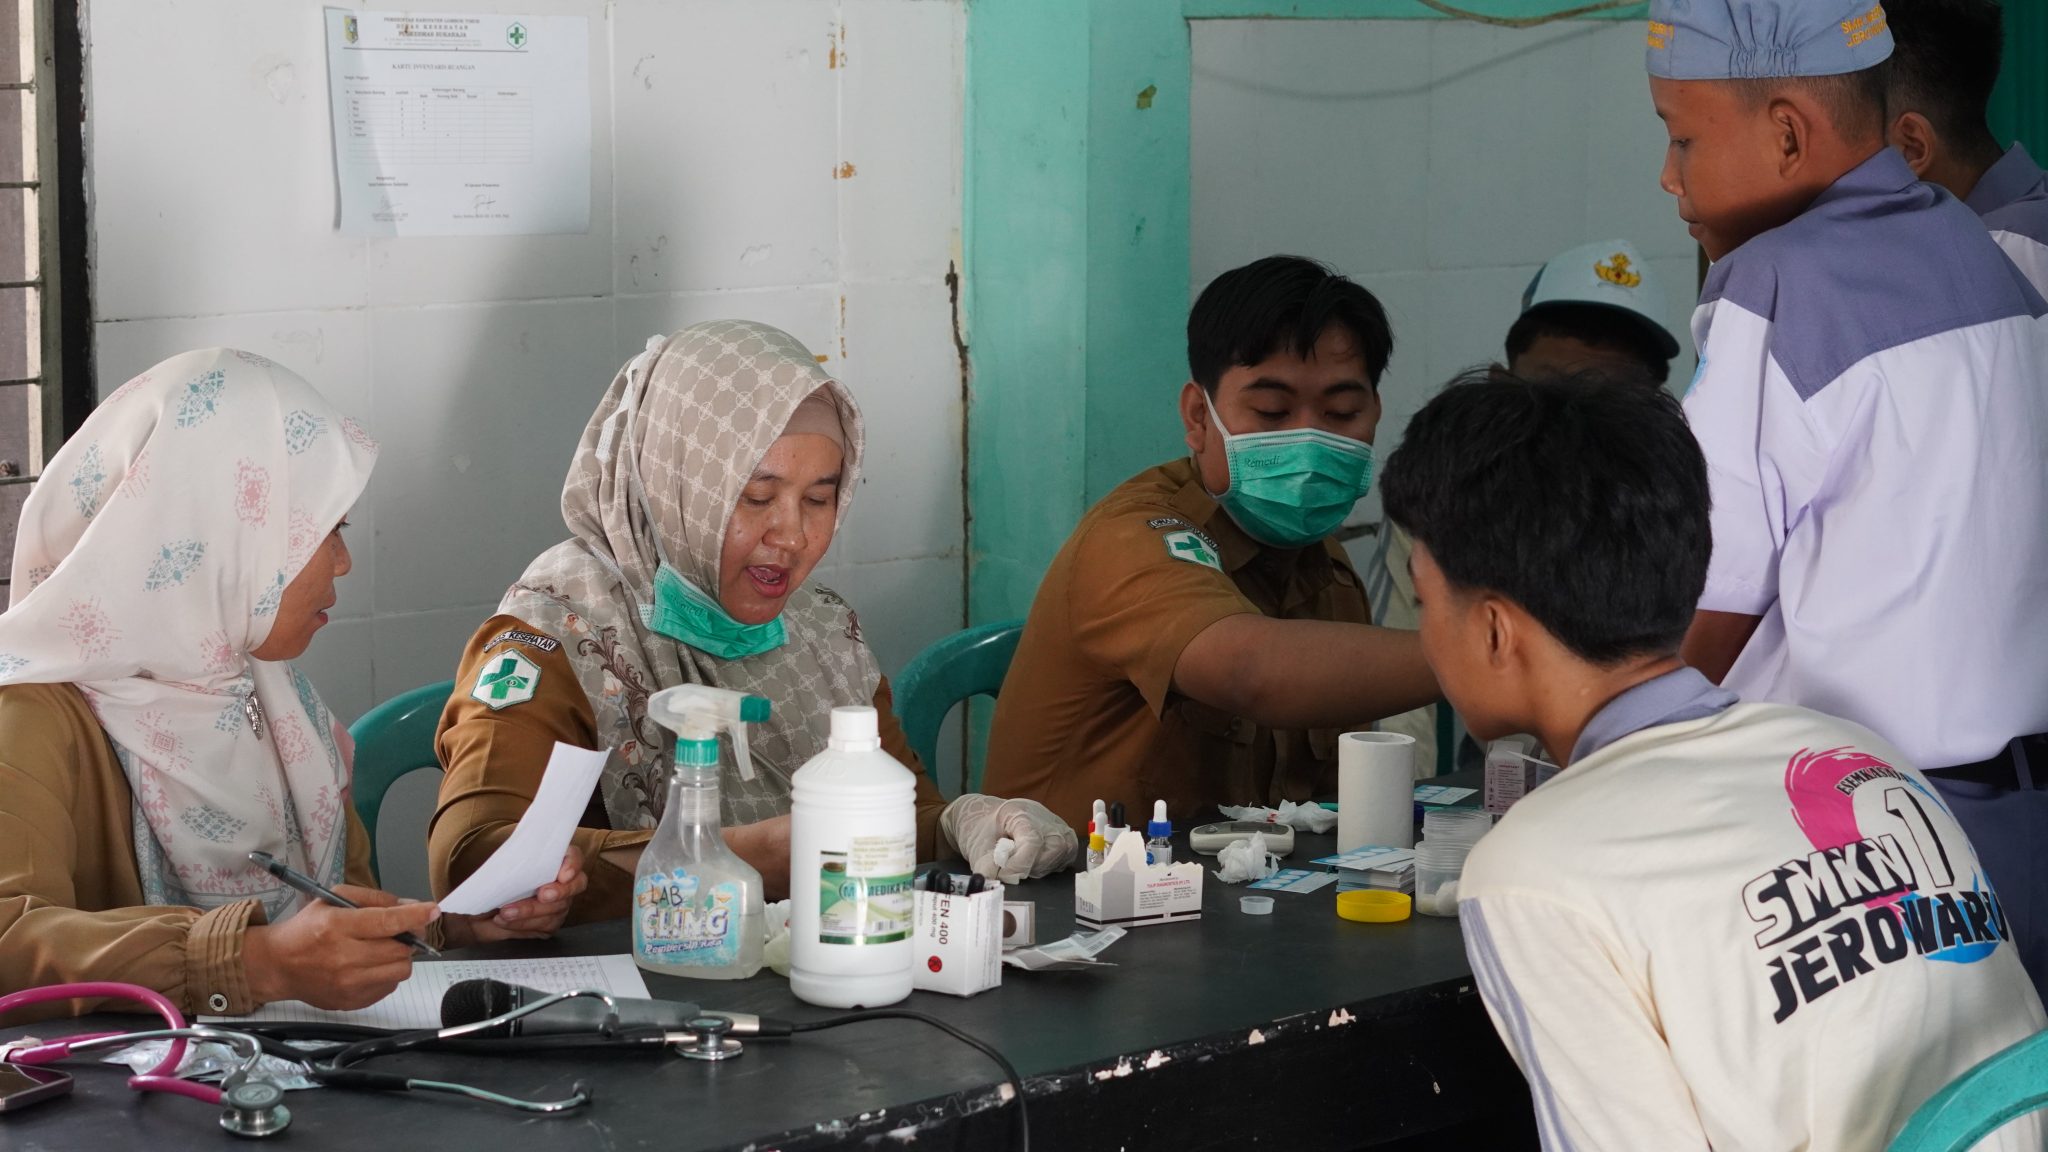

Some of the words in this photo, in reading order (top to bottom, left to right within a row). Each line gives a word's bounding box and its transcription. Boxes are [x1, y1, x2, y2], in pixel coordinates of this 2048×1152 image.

[508, 632, 556, 651] KESEHATAN
[1742, 834, 1919, 949] SMKN
[1884, 787, 1955, 888] 1
[651, 884, 683, 907] LAB
[938, 921, 949, 945] 400
